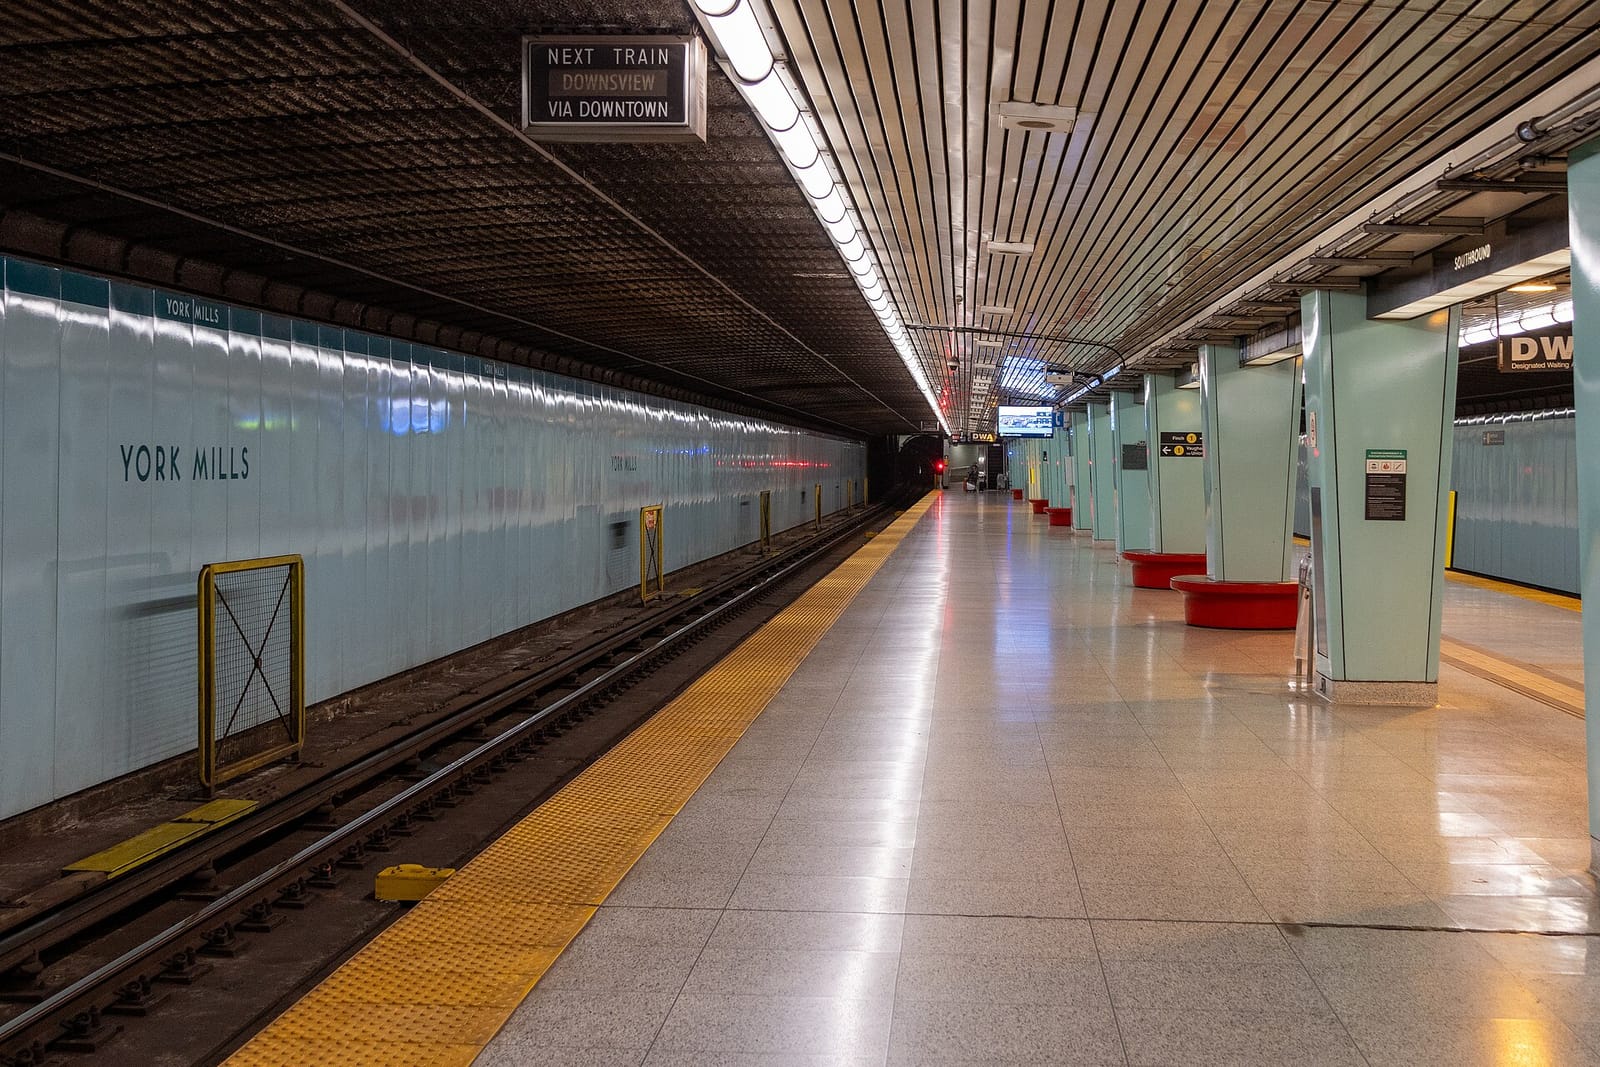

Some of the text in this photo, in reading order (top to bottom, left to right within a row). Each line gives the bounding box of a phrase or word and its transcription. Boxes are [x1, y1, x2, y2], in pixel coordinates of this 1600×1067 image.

[548, 48, 668, 65] NEXT TRAIN
[562, 73, 656, 91] DOWNSVIEW
[548, 101, 668, 117] VIA DOWNTOWN
[1454, 243, 1491, 271] SOUTHBOUND
[166, 298, 219, 324] YORK MILLS
[1511, 362, 1546, 370] Designated
[1547, 361, 1570, 370] Waiting
[972, 433, 994, 441] DWA
[120, 444, 249, 482] YORK MILLS
